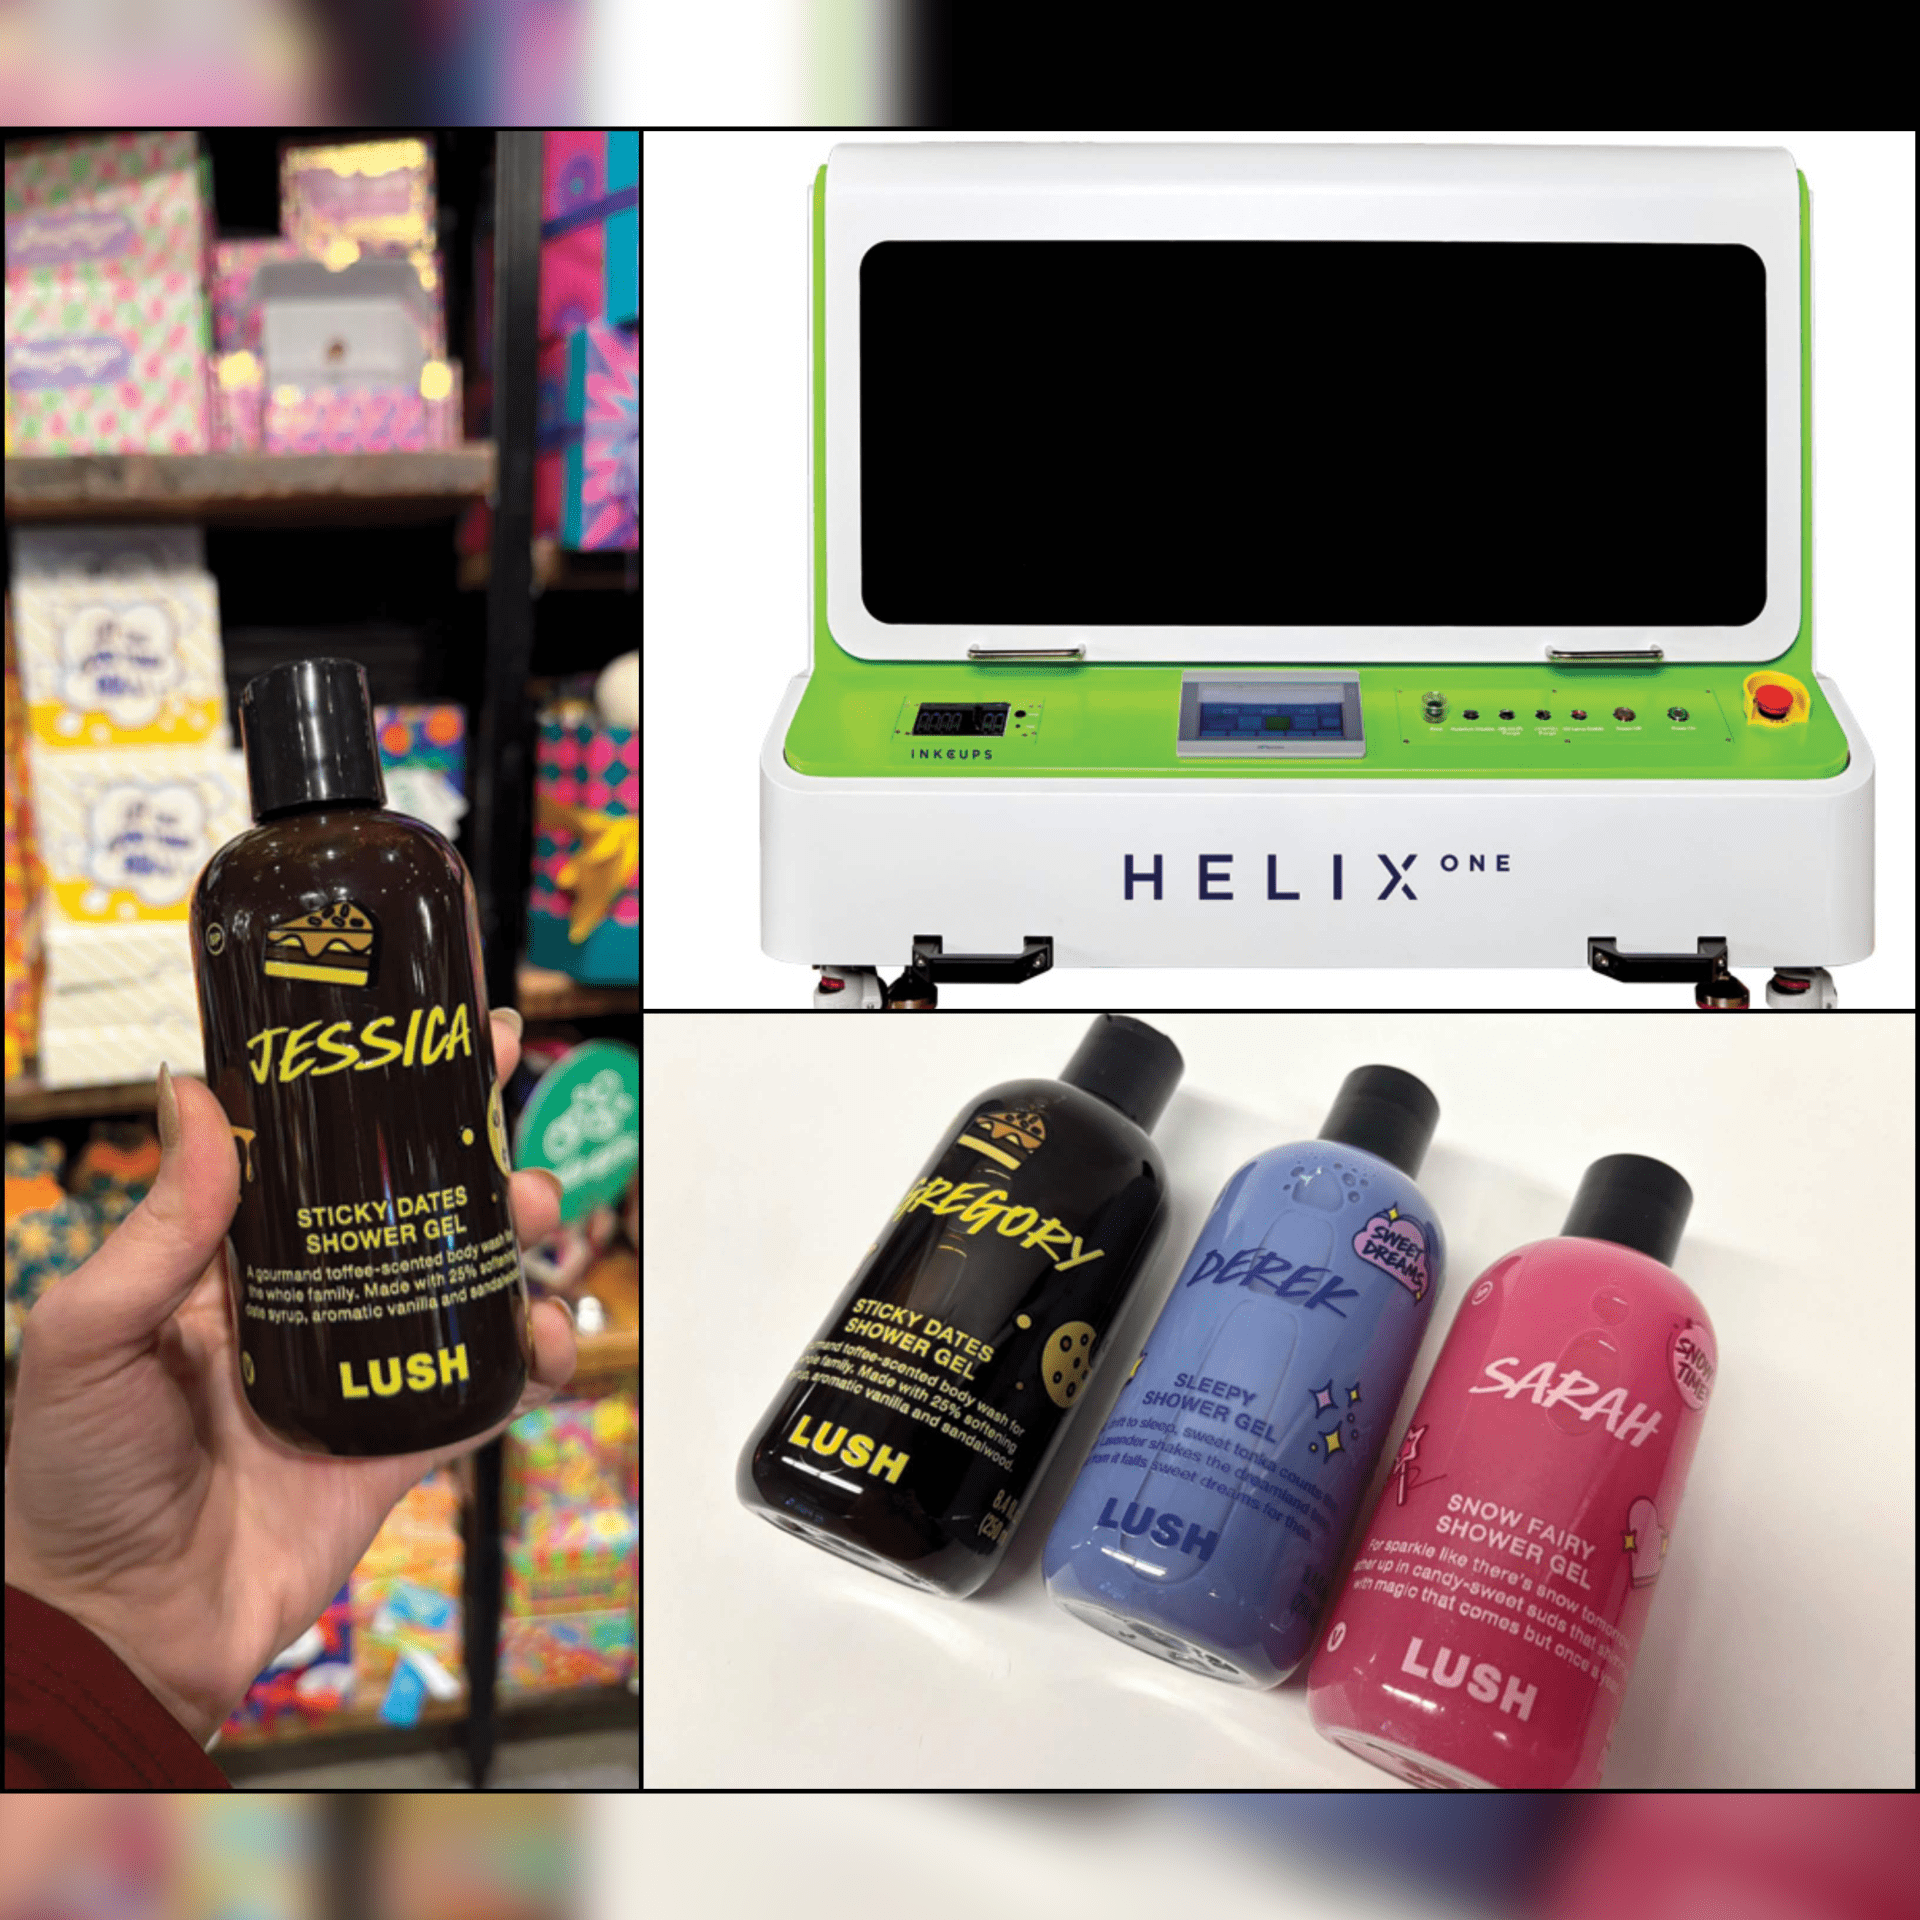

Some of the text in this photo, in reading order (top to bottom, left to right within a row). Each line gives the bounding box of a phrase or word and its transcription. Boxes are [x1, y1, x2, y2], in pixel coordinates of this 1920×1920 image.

[1124, 854, 1510, 900] HELIX ONE
[247, 1003, 471, 1085] JESSICA
[297, 1185, 468, 1229] STICKY DATES
[306, 1214, 467, 1255] SHOWER GEL
[893, 1176, 1105, 1271] GREGORY
[325, 1252, 443, 1281] toffee-scented
[447, 1243, 479, 1264] body
[1361, 1239, 1426, 1287] DREAMS
[1371, 1225, 1425, 1261] SWEET
[307, 1285, 360, 1304] family.
[363, 1280, 410, 1299] Made
[413, 1272, 445, 1291] with
[448, 1263, 478, 1284] 25%
[312, 1302, 383, 1323] aromatic
[386, 1296, 438, 1316] vanilla
[441, 1286, 468, 1308] and
[1186, 1248, 1360, 1318] DEREK
[844, 1317, 977, 1381] SHOWER GEL
[852, 1298, 995, 1363] STICKY DATES
[1675, 1337, 1715, 1382] SNOW
[339, 1343, 470, 1399] LUSH
[841, 1341, 938, 1387] toffee-scented
[938, 1379, 975, 1408] body
[976, 1398, 1009, 1429] wash
[1009, 1417, 1026, 1438] for
[1173, 1372, 1258, 1408] SLEEPY
[1468, 1356, 1663, 1448] SARAH
[857, 1363, 898, 1389] Made
[899, 1378, 930, 1404] with
[929, 1391, 962, 1420] 25%
[963, 1412, 1018, 1456] softening
[865, 1383, 911, 1416] vanilla
[911, 1404, 944, 1429] and
[941, 1419, 1014, 1474] sandalwood.
[1142, 1390, 1278, 1444] SHOWER GEL
[788, 1415, 911, 1485] LUSH
[1148, 1439, 1202, 1463] shakes
[1205, 1453, 1232, 1474] the
[1182, 1426, 1232, 1454] sweet
[1233, 1442, 1278, 1474] tonka
[1279, 1467, 1323, 1501] counts
[1150, 1460, 1198, 1483] sweet
[1199, 1475, 1260, 1510] dreams
[1261, 1501, 1284, 1521] for
[1096, 1497, 1219, 1562] LUSH
[1435, 1514, 1594, 1590] SHOWER GEL
[1446, 1493, 1598, 1562] SNOW FAIRY
[1377, 1559, 1395, 1574] up
[1395, 1558, 1411, 1575] in
[1411, 1563, 1525, 1613] candy-sweet
[1526, 1601, 1568, 1634] suds
[1569, 1622, 1598, 1652] that
[1384, 1539, 1437, 1559] sparkle
[1438, 1545, 1469, 1569] like
[1471, 1557, 1534, 1592] there's
[1535, 1581, 1580, 1614] snow
[1374, 1579, 1420, 1600] magic
[1421, 1585, 1457, 1613] that
[1458, 1601, 1522, 1637] comes
[1523, 1623, 1553, 1652] but
[1553, 1642, 1591, 1673] once
[1401, 1636, 1539, 1723] LUSH
